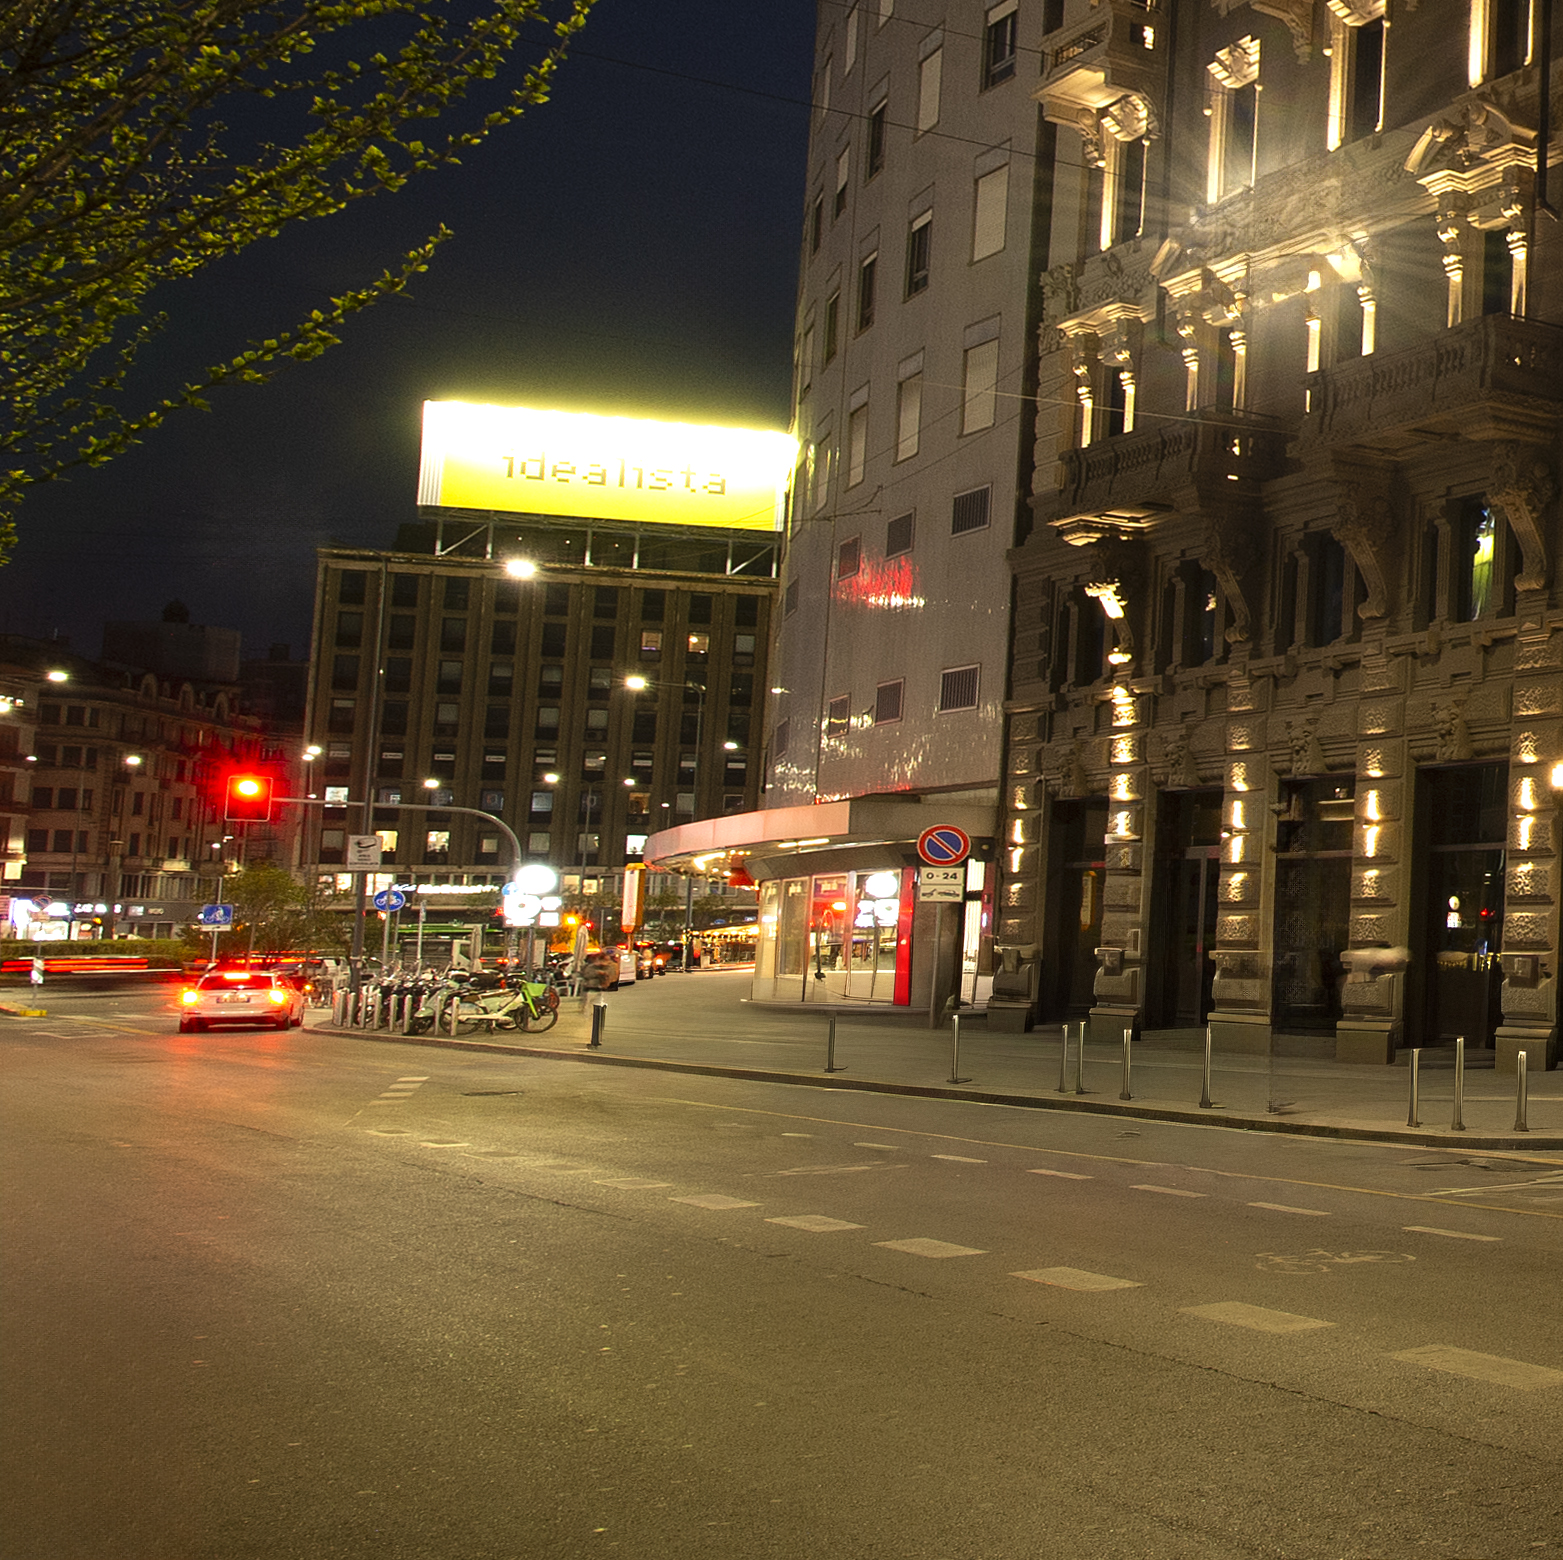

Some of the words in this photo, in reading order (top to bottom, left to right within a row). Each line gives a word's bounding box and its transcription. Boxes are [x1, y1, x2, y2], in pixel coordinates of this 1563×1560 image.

[501, 450, 727, 496] idealista
[926, 872, 935, 880] 0
[942, 872, 958, 880] 24
